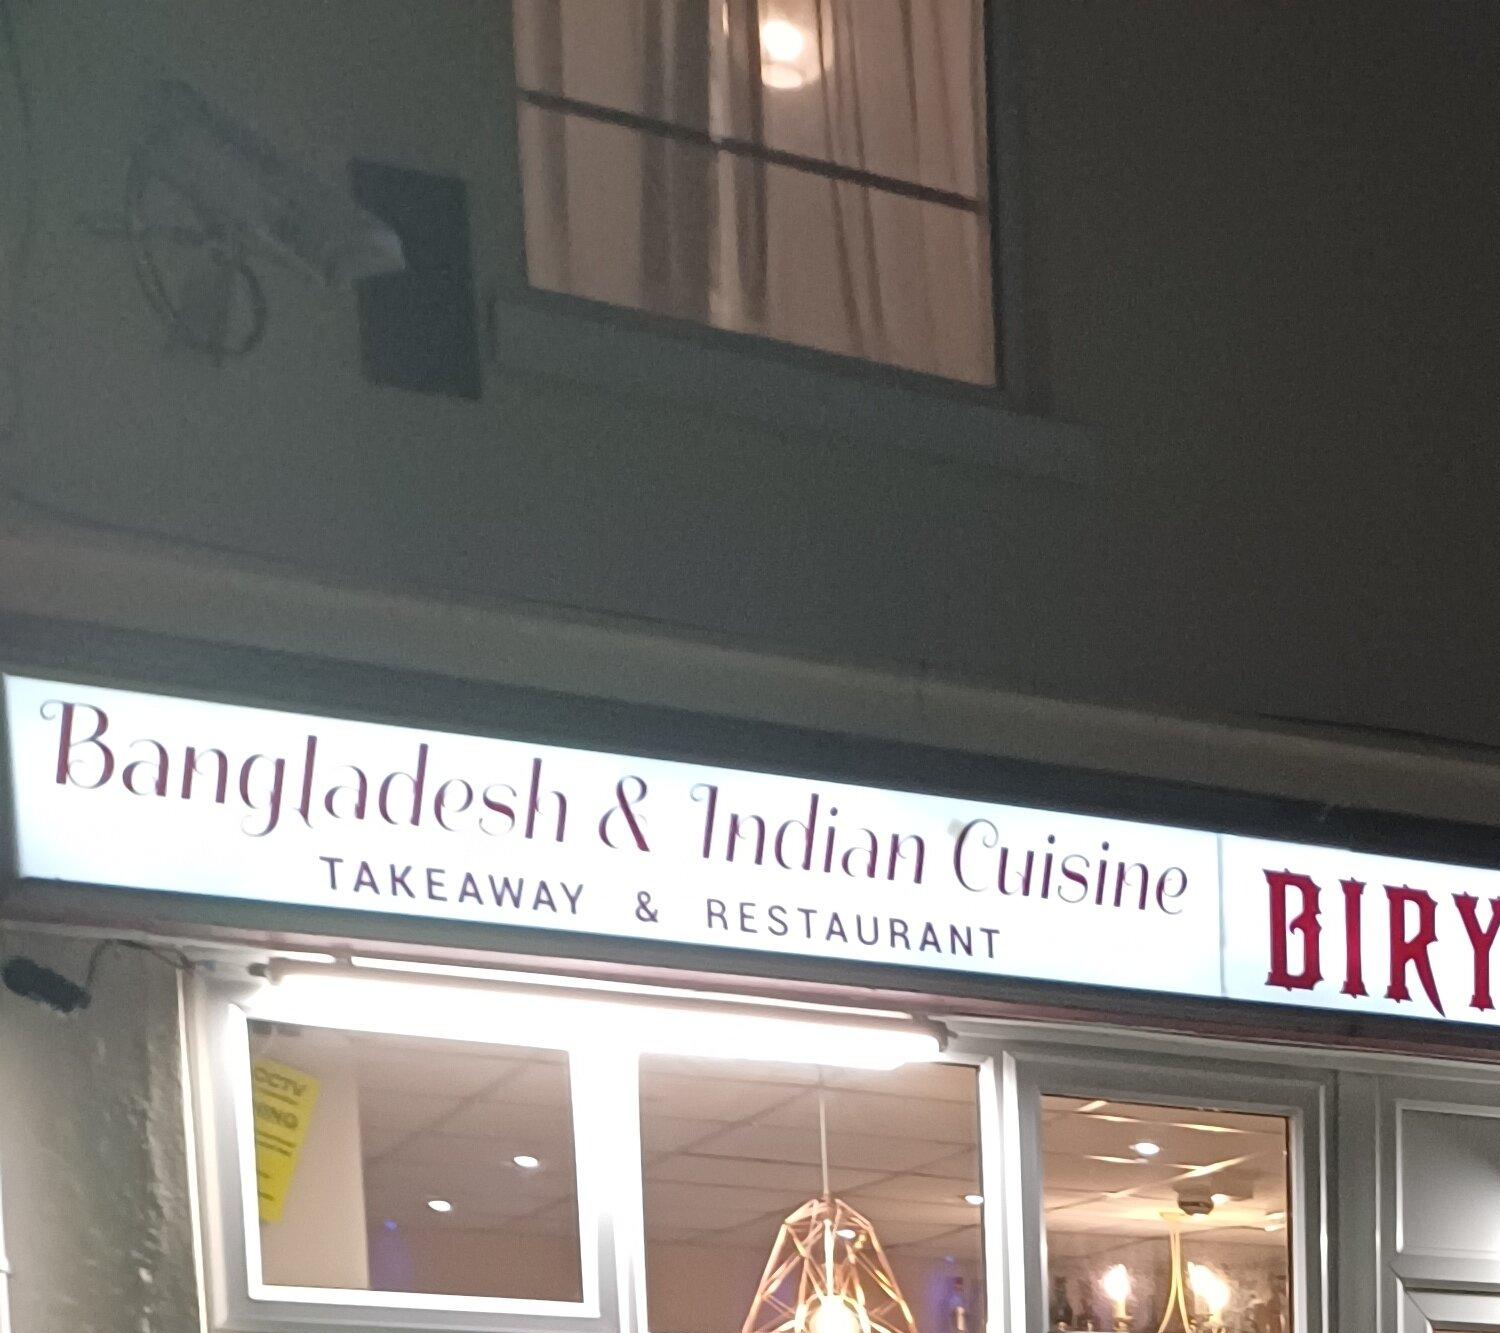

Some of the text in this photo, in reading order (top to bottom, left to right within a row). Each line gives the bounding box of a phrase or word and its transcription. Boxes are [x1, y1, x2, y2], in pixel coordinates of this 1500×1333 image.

[40, 700, 1189, 915] Bangladesh & Indian Cuisine
[319, 856, 1001, 959] TAKEAWAY & RESTAURANT
